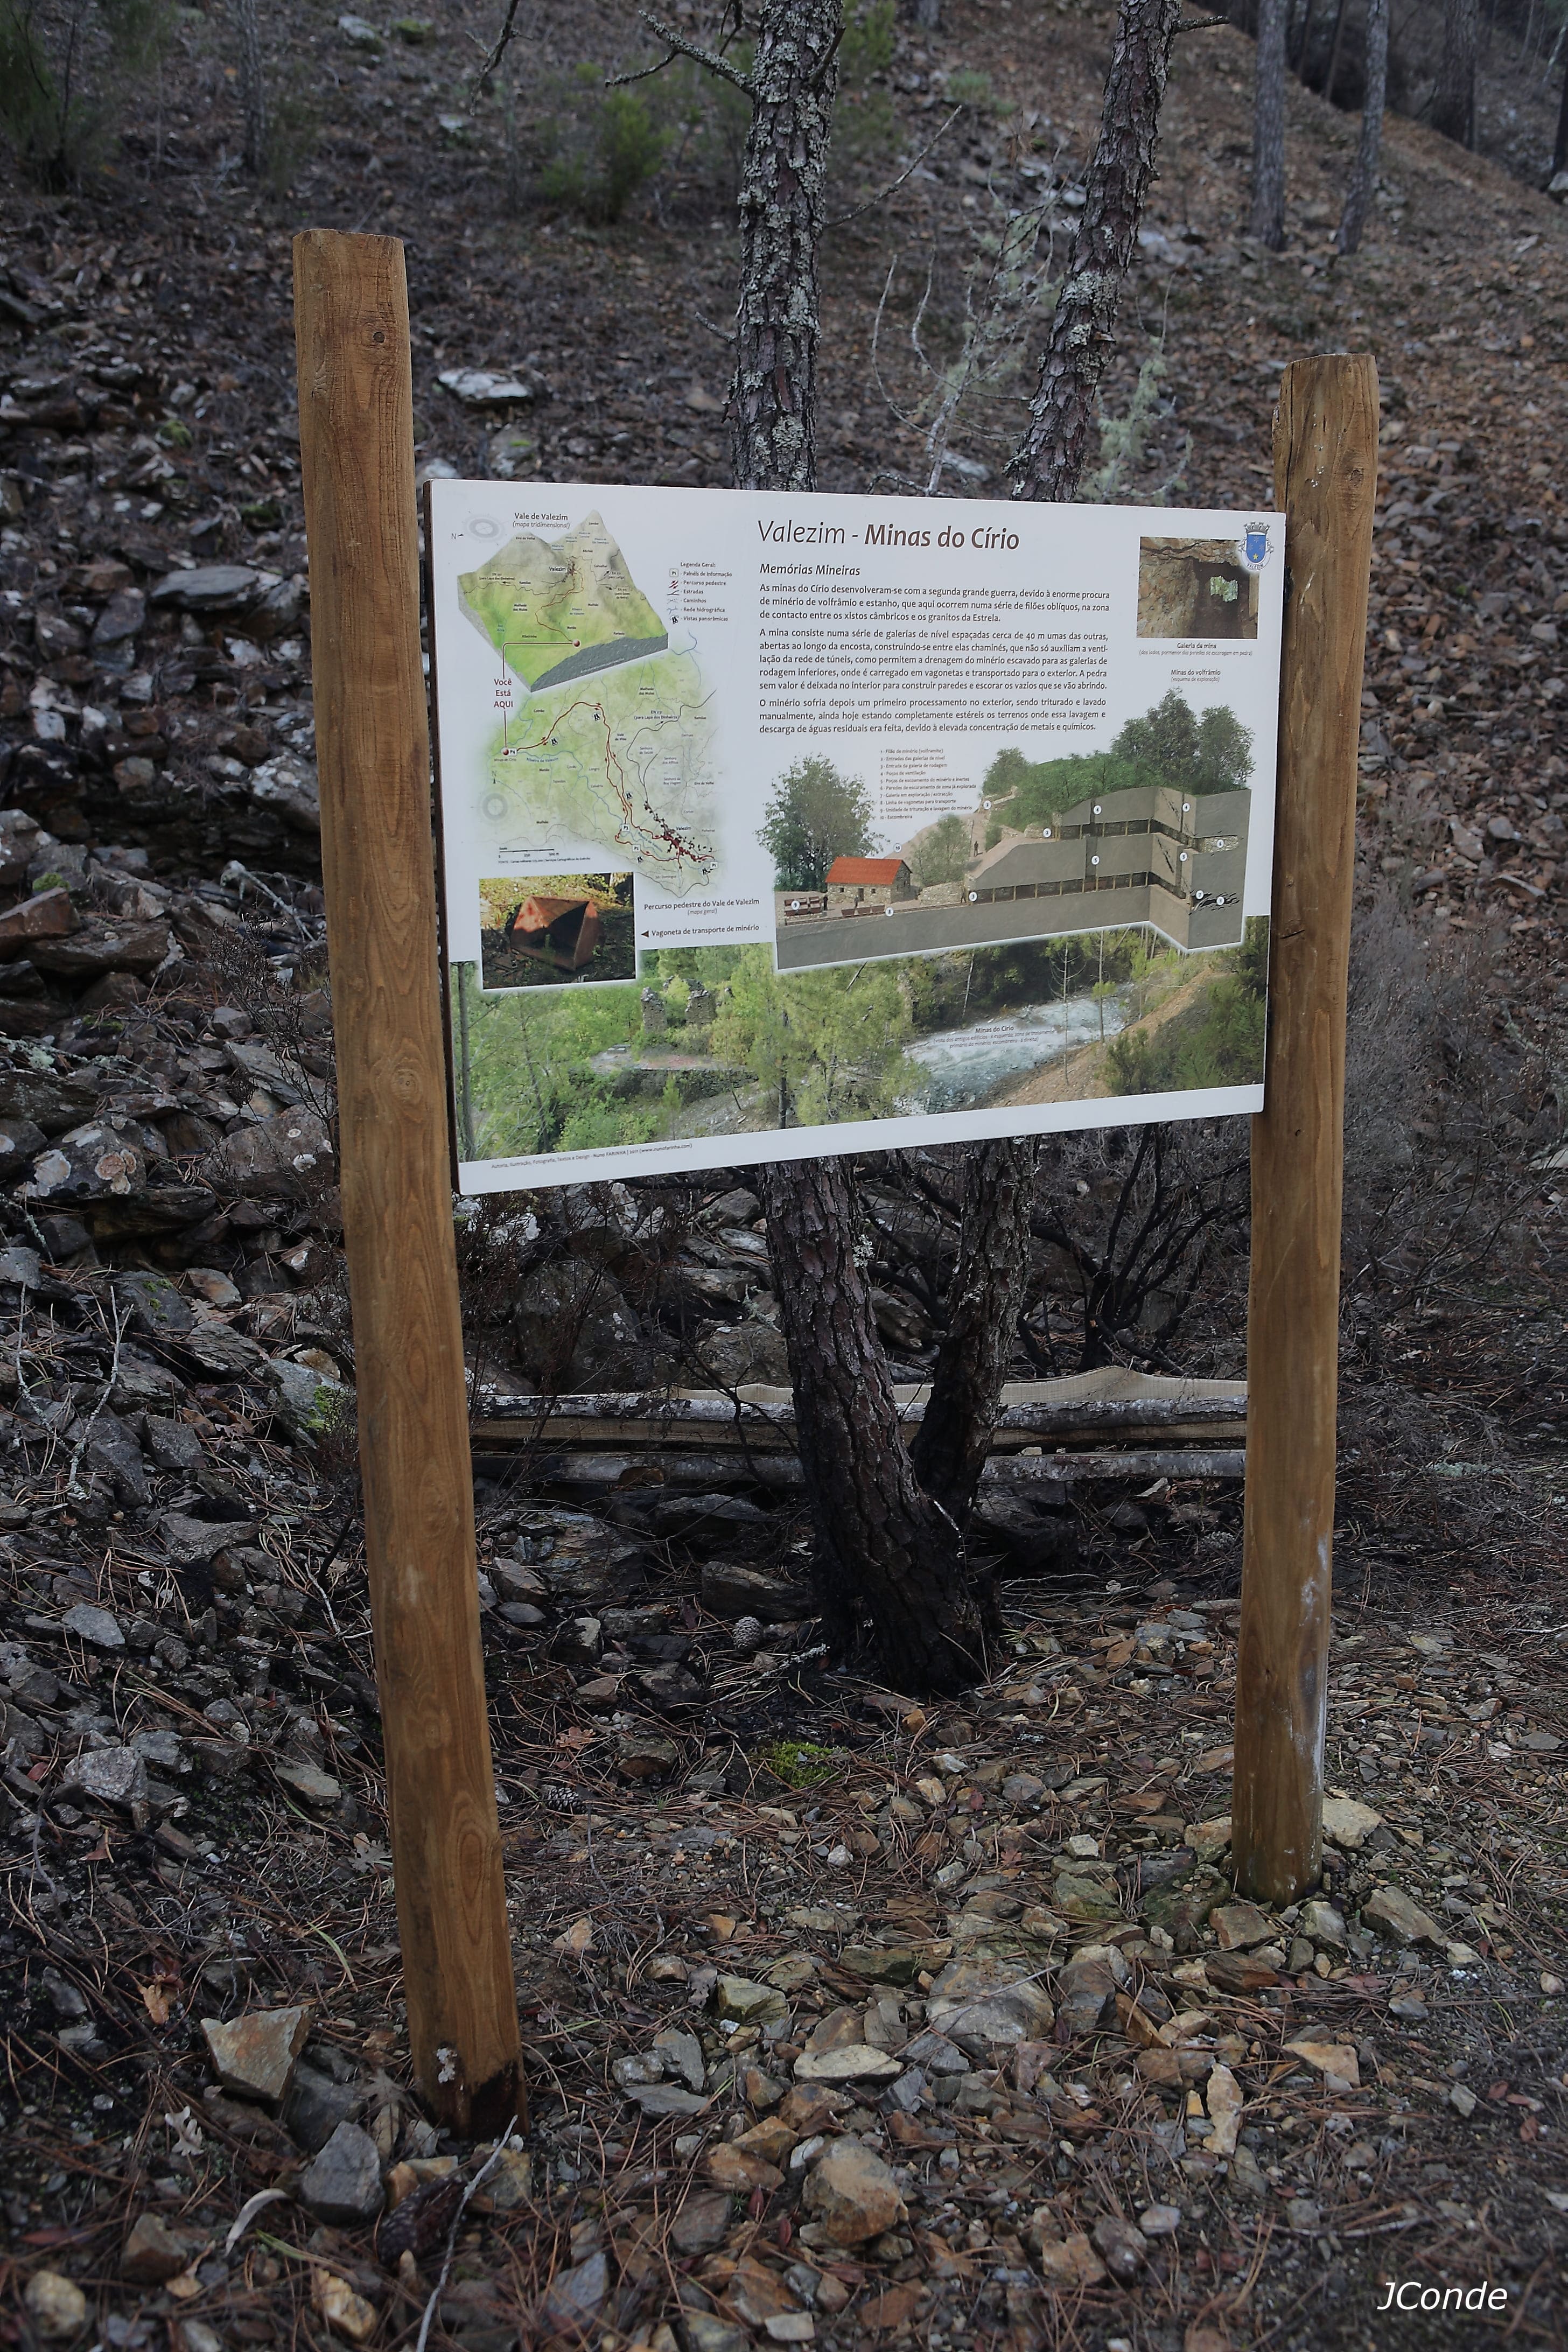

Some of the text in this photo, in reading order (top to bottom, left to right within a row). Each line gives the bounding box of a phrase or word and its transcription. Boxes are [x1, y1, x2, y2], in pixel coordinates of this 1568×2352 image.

[758, 520, 844, 544] Valezim
[864, 523, 930, 547] Minas
[937, 525, 964, 548] do
[971, 527, 1019, 550] Círio
[760, 563, 860, 576] Memórias Mineiras
[772, 583, 796, 592] minas
[798, 584, 808, 592] do
[810, 584, 829, 592] Círio
[831, 584, 902, 594] desenvolveram-se
[928, 587, 960, 597] segunda
[962, 587, 989, 598] grande
[990, 590, 1018, 598] guerra,
[1019, 589, 1044, 597] devido
[760, 596, 769, 605] de
[772, 597, 803, 605] minério
[806, 597, 816, 605] de
[818, 597, 857, 606] volfrâmio
[866, 599, 899, 608] estanho,
[918, 600, 934, 610] aqui
[994, 601, 1012, 609] série
[1014, 601, 1023, 610] de
[1025, 601, 1045, 610] filões
[1047, 602, 1080, 612] oblíquos,
[760, 610, 769, 618] de
[844, 611, 867, 619] xistos
[870, 612, 909, 620] câmbricos
[928, 613, 960, 623] granitos
[973, 613, 1000, 621] Estrela.
[769, 628, 788, 636] mina
[792, 628, 824, 636] consiste
[852, 629, 871, 637] série
[873, 629, 883, 637] de
[886, 629, 916, 640] galerias
[919, 629, 928, 638] de
[951, 631, 989, 640] espaçadas
[1083, 633, 1108, 641] outras,
[760, 641, 789, 649] abertas
[804, 641, 826, 652] longo
[840, 643, 872, 652] encosta,
[874, 642, 930, 650] construindo-se
[971, 643, 1008, 653] chaminés,
[1025, 643, 1039, 652] não
[1040, 643, 1048, 652] só
[760, 654, 780, 665] lação
[783, 654, 792, 662] da
[795, 654, 813, 663] rede
[815, 654, 824, 663] de
[827, 655, 852, 664] túneis,
[879, 655, 916, 666] permitem
[925, 655, 963, 666] drenagem
[1007, 656, 1040, 664] escavado
[1069, 656, 1097, 667] galerias
[493, 701, 513, 709] AQUI
[673, 901, 701, 910] pedestre
[652, 929, 681, 937] Vagoneta
